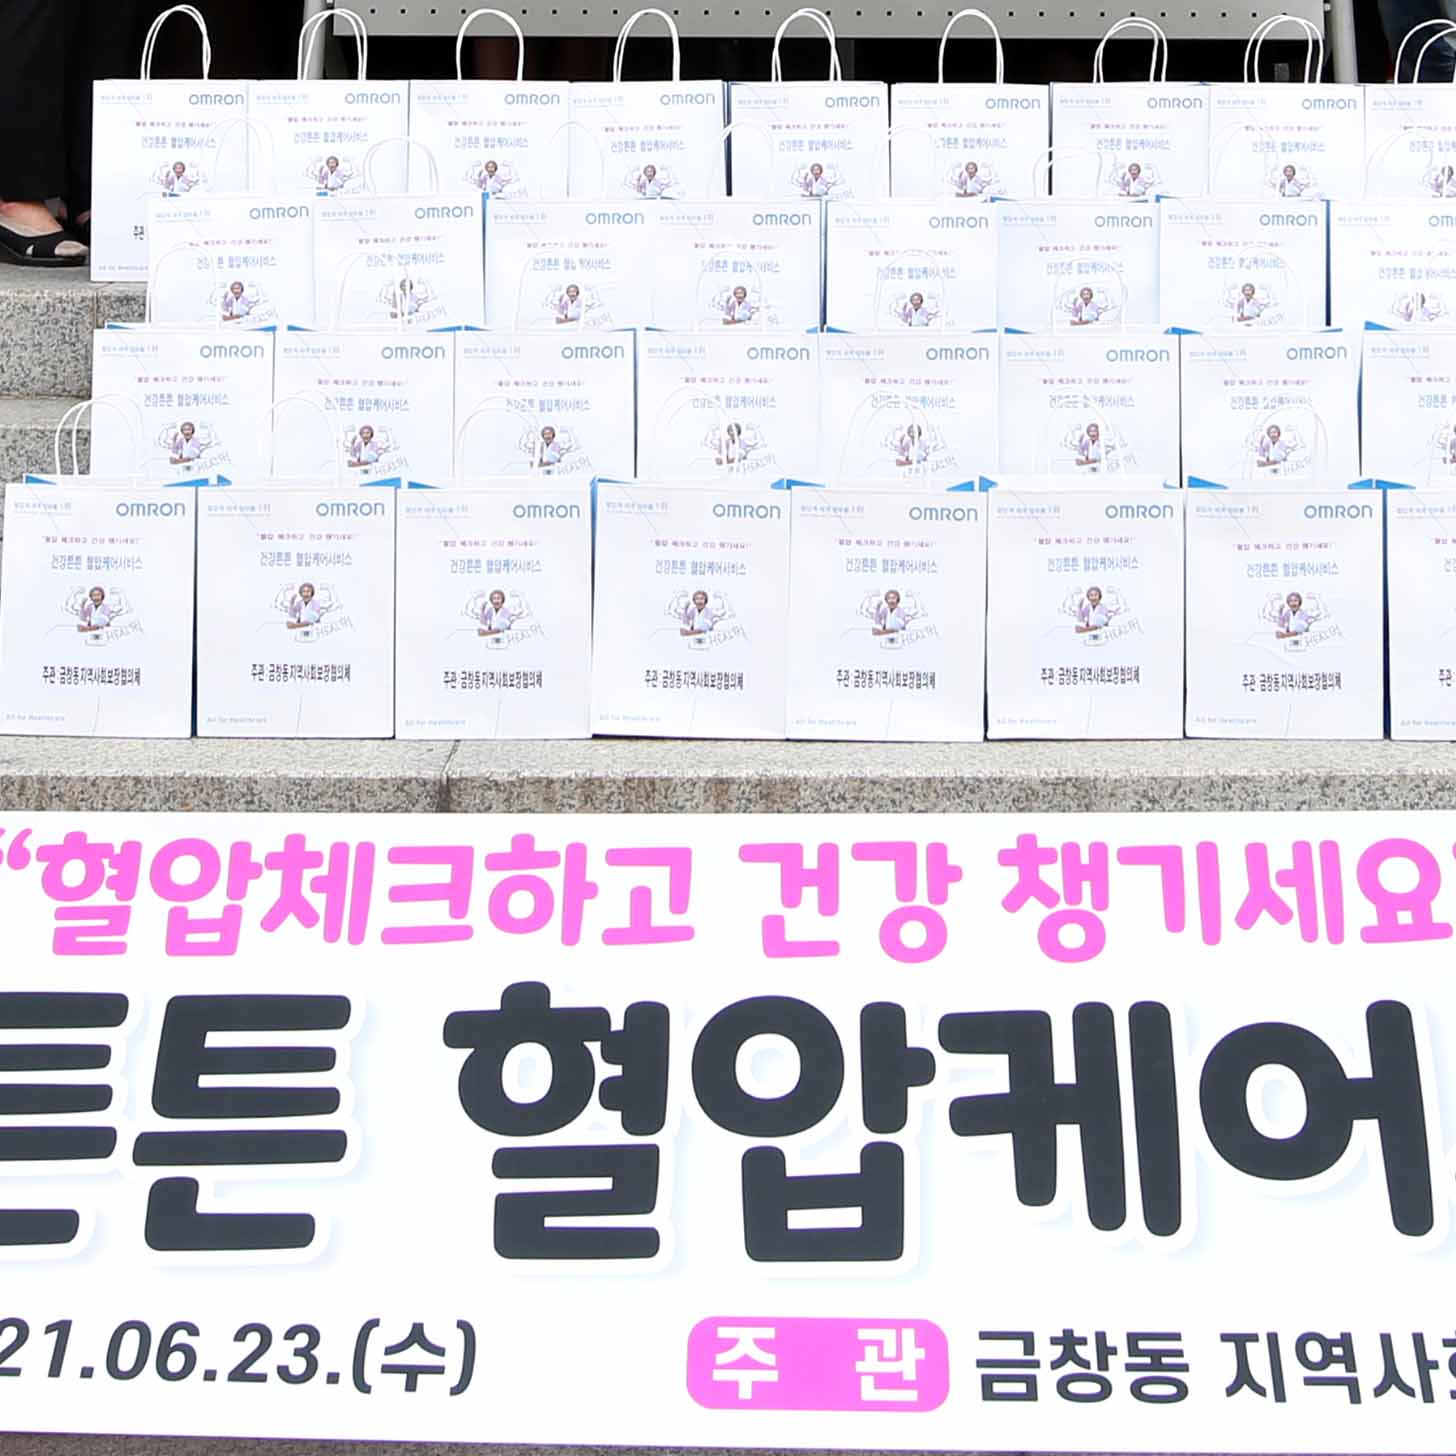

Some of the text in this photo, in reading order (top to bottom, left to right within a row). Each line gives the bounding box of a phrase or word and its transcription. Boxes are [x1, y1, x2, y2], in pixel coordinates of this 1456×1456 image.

[188, 93, 245, 106] OMRON
[344, 91, 401, 105] OMRON
[503, 93, 561, 106] OMRON
[659, 92, 716, 107] OMRON
[824, 95, 881, 109] OMRON
[984, 97, 1041, 110] OMRON
[1146, 96, 1203, 110] OMRON
[1301, 97, 1358, 111] OMRON
[248, 205, 310, 221] OMRON
[414, 205, 474, 220] OMRON
[584, 211, 645, 225] OMRON
[751, 213, 812, 227] OMRON
[1258, 213, 1319, 227] OMRON
[928, 215, 989, 230] OMRON
[1093, 215, 1153, 229] OMRON
[199, 344, 265, 359] OMRON
[380, 345, 446, 360] OMRON
[560, 345, 625, 360] OMRON
[746, 346, 811, 361] OMRON
[925, 346, 990, 361] OMRON
[1105, 348, 1170, 363] OMRON
[1286, 345, 1348, 361] OMRON
[115, 502, 186, 517] OMRON
[315, 502, 385, 517] OMRON
[512, 503, 581, 519] OMRON
[712, 503, 782, 520] OMRON
[908, 506, 979, 522] OMRON
[1104, 504, 1174, 520] OMRON
[1303, 504, 1373, 520] OMRON
[738, 840, 960, 964] 건강
[975, 1328, 1191, 1405] 금창동
